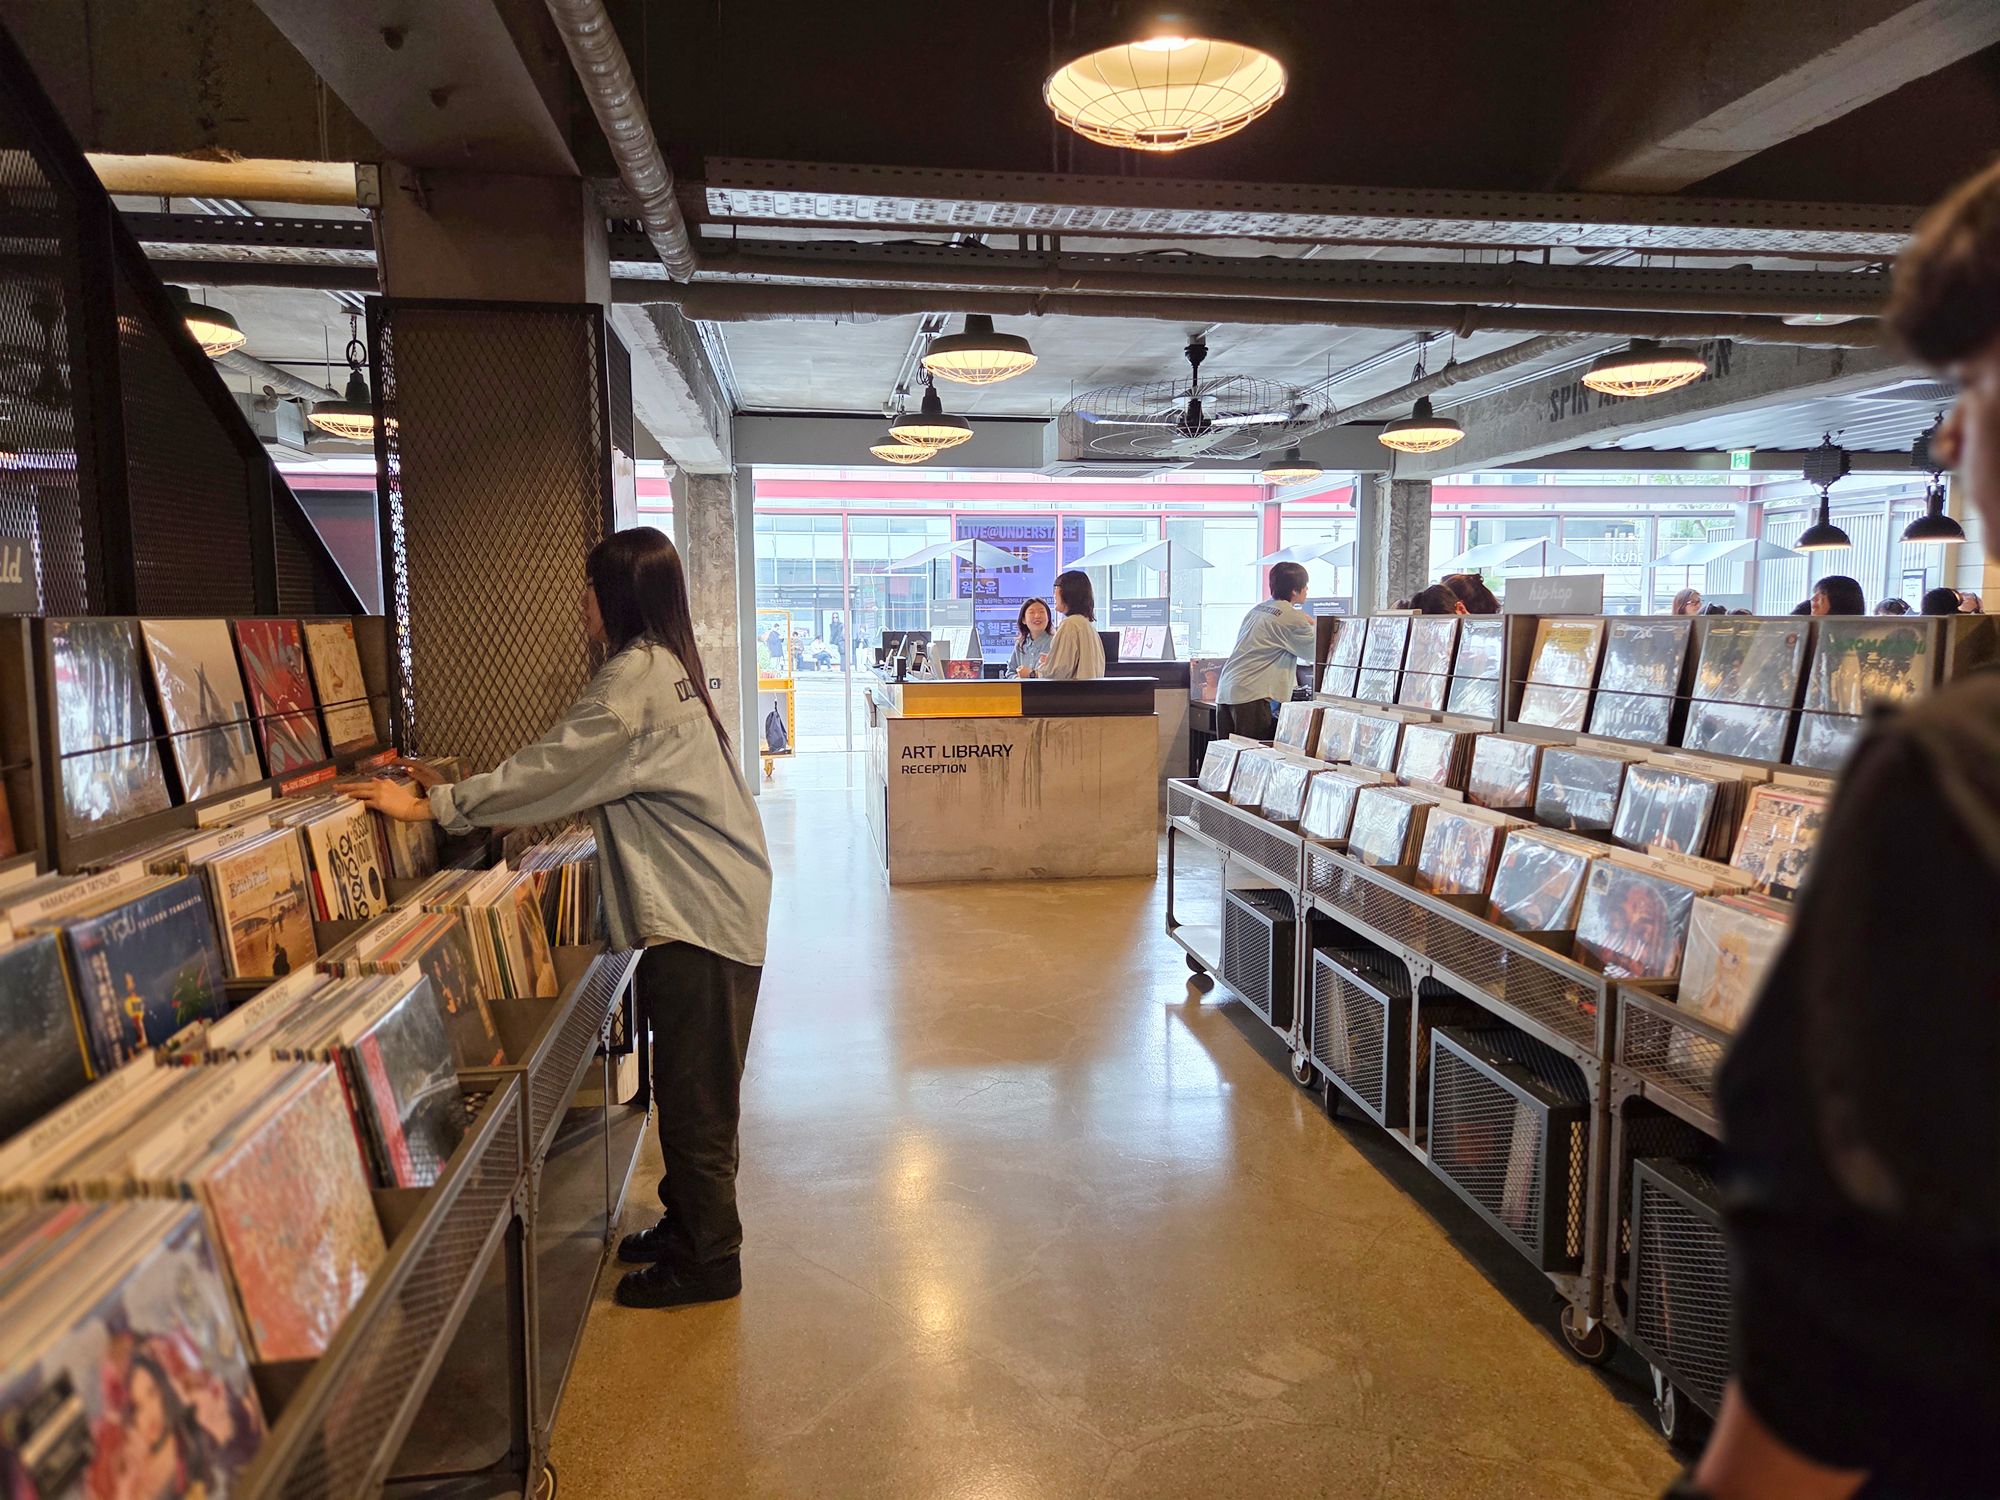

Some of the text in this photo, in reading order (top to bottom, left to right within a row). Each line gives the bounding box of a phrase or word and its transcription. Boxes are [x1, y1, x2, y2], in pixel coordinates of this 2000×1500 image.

[901, 744, 1014, 759] ART LIBRARY
[901, 764, 967, 774] RECEPTION
